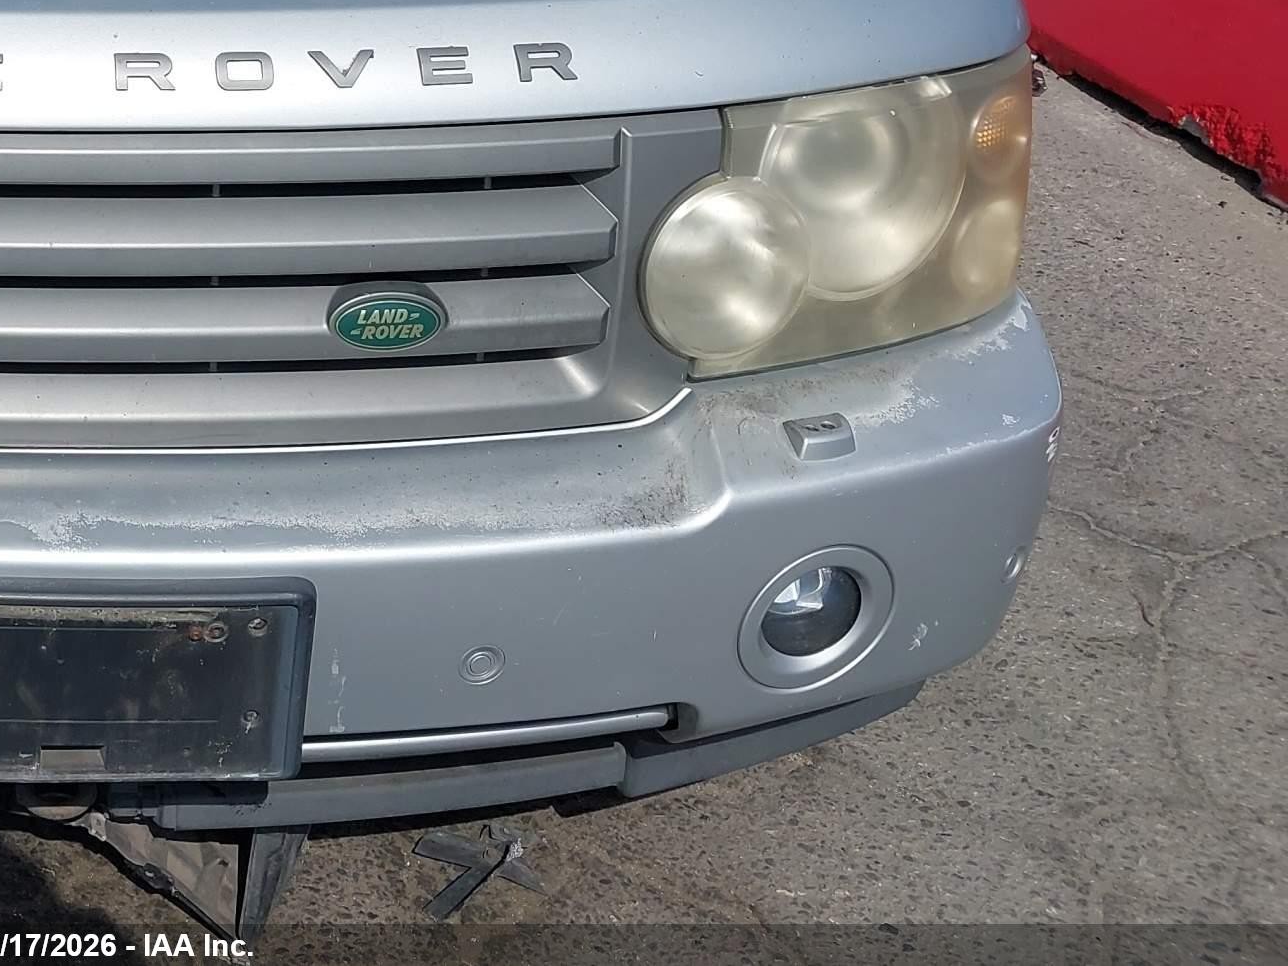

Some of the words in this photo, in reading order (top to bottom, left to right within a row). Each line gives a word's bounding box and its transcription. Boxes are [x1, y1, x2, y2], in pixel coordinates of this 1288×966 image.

[114, 42, 578, 91] ROVER
[357, 309, 409, 325] LAND
[360, 323, 425, 340] ROVER
